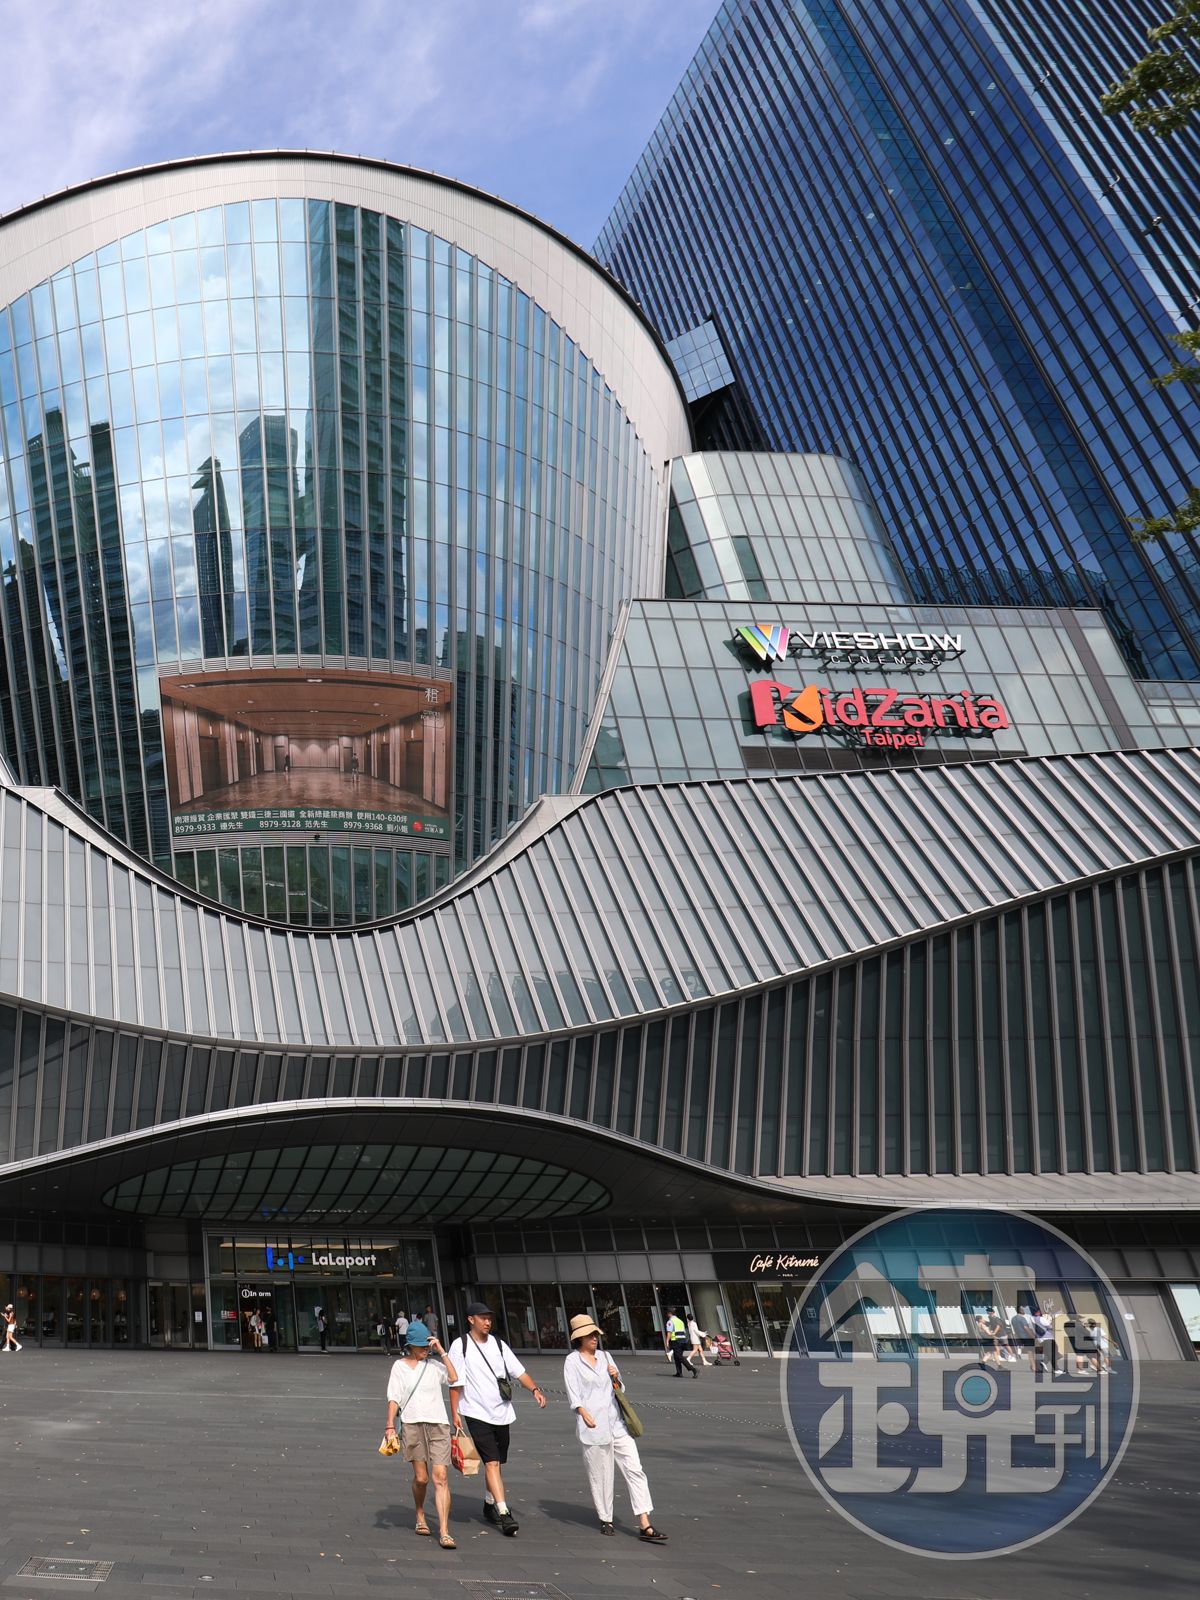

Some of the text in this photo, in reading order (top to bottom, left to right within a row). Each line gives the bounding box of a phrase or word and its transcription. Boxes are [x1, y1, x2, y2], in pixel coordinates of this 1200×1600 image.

[795, 630, 963, 652] VIESHOW
[831, 654, 942, 666] CINEMAS
[425, 687, 439, 704] 租
[750, 679, 1009, 733] KidZania
[860, 728, 925, 750] Taipei
[175, 823, 216, 833] 8979-9333
[259, 820, 301, 829] 8979-9128
[343, 822, 384, 831] 8979-9368
[311, 1252, 377, 1269] LaLaport
[750, 1254, 820, 1273] Café Kitsuné
